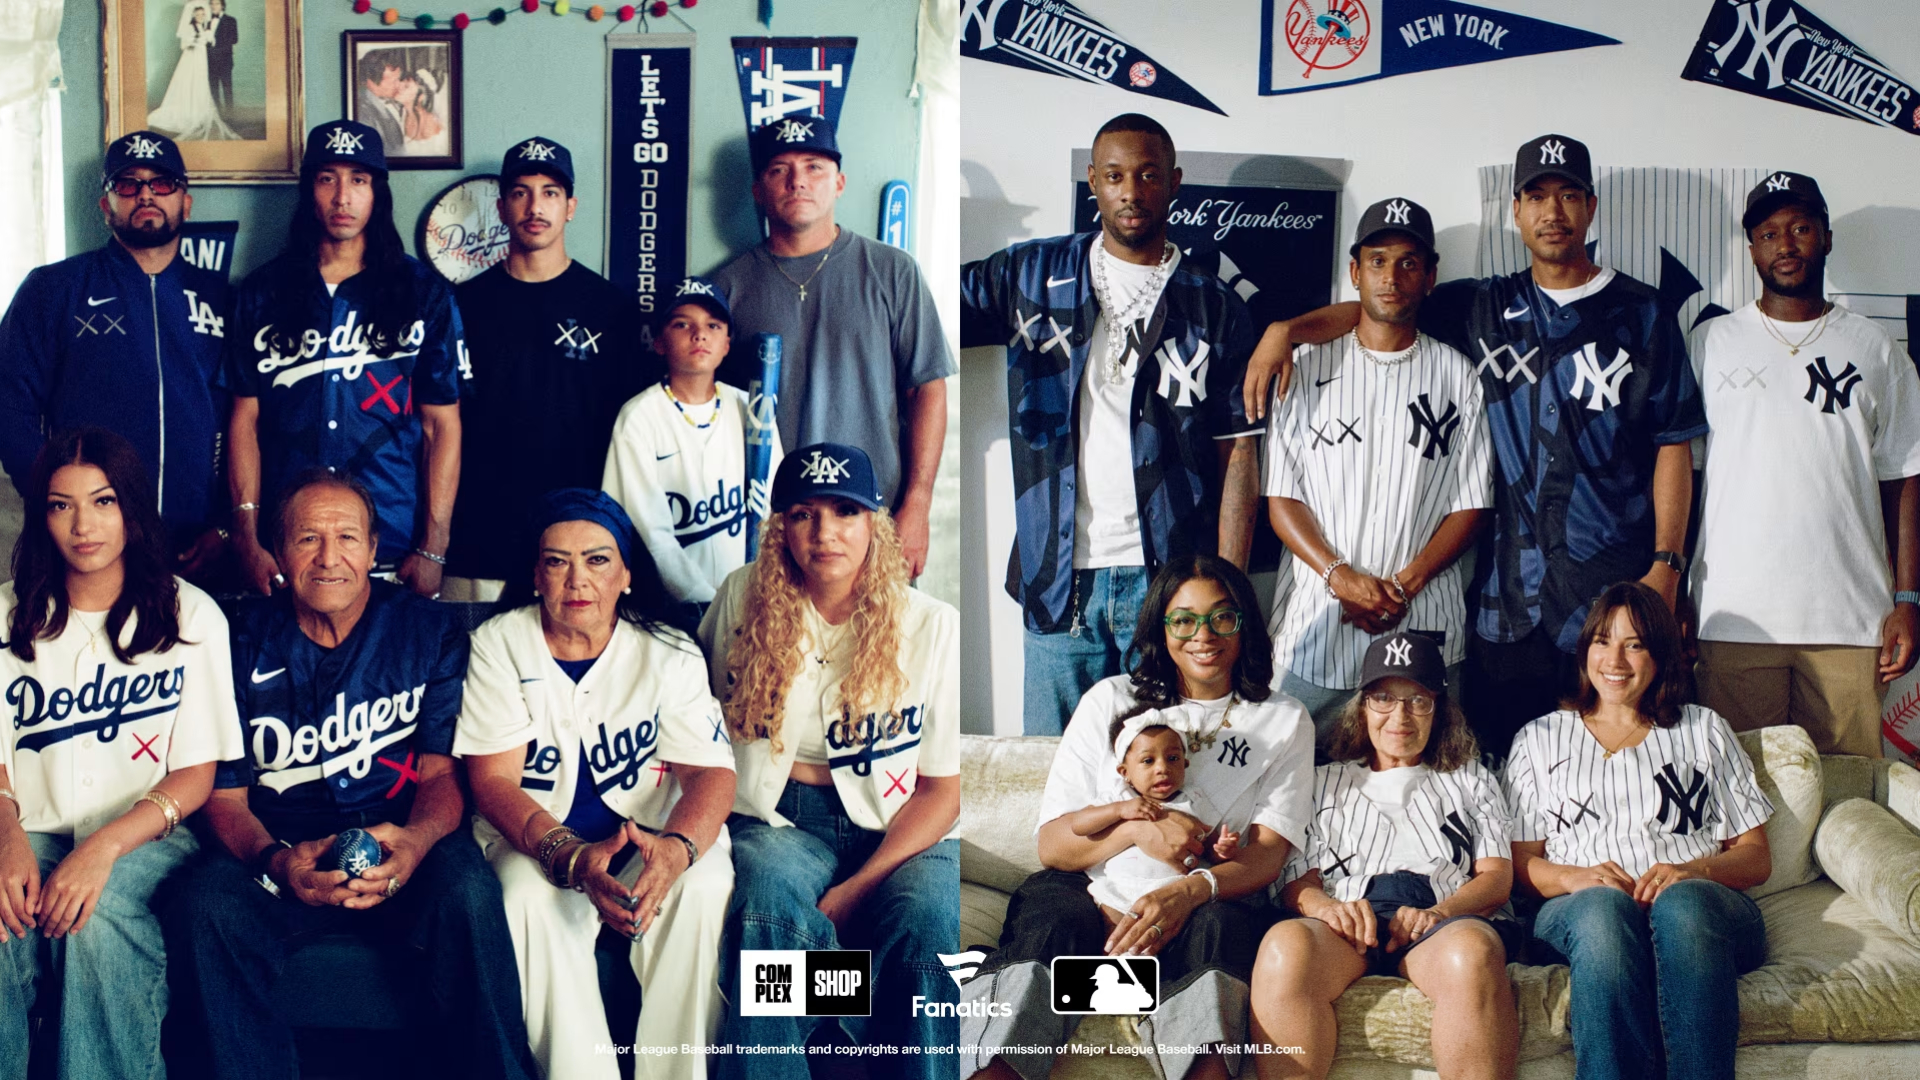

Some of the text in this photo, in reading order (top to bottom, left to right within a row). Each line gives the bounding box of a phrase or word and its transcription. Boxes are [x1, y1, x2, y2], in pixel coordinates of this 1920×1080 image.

[1011, 4, 1127, 80] YANKEES
[1286, 11, 1370, 48] Yankees
[1399, 13, 1509, 50] NEW YORK
[1810, 29, 1856, 60] New York
[1799, 45, 1911, 123] YANKEES
[633, 142, 669, 163] GO
[1540, 139, 1567, 165] NY
[1765, 173, 1791, 193] NY
[1167, 198, 1213, 227] ork
[1384, 199, 1412, 225] NY
[180, 237, 226, 271] ANI
[438, 222, 511, 257] Dodge
[637, 169, 659, 312] DODGERS
[183, 288, 225, 338] LA
[1154, 336, 1210, 407] NY
[1569, 341, 1634, 411] NY
[1803, 355, 1863, 414] NY
[1407, 393, 1460, 460] NY
[665, 479, 747, 538] Dodg
[1384, 637, 1413, 667] NY
[1217, 735, 1252, 768] NY
[1653, 762, 1710, 835] NY
